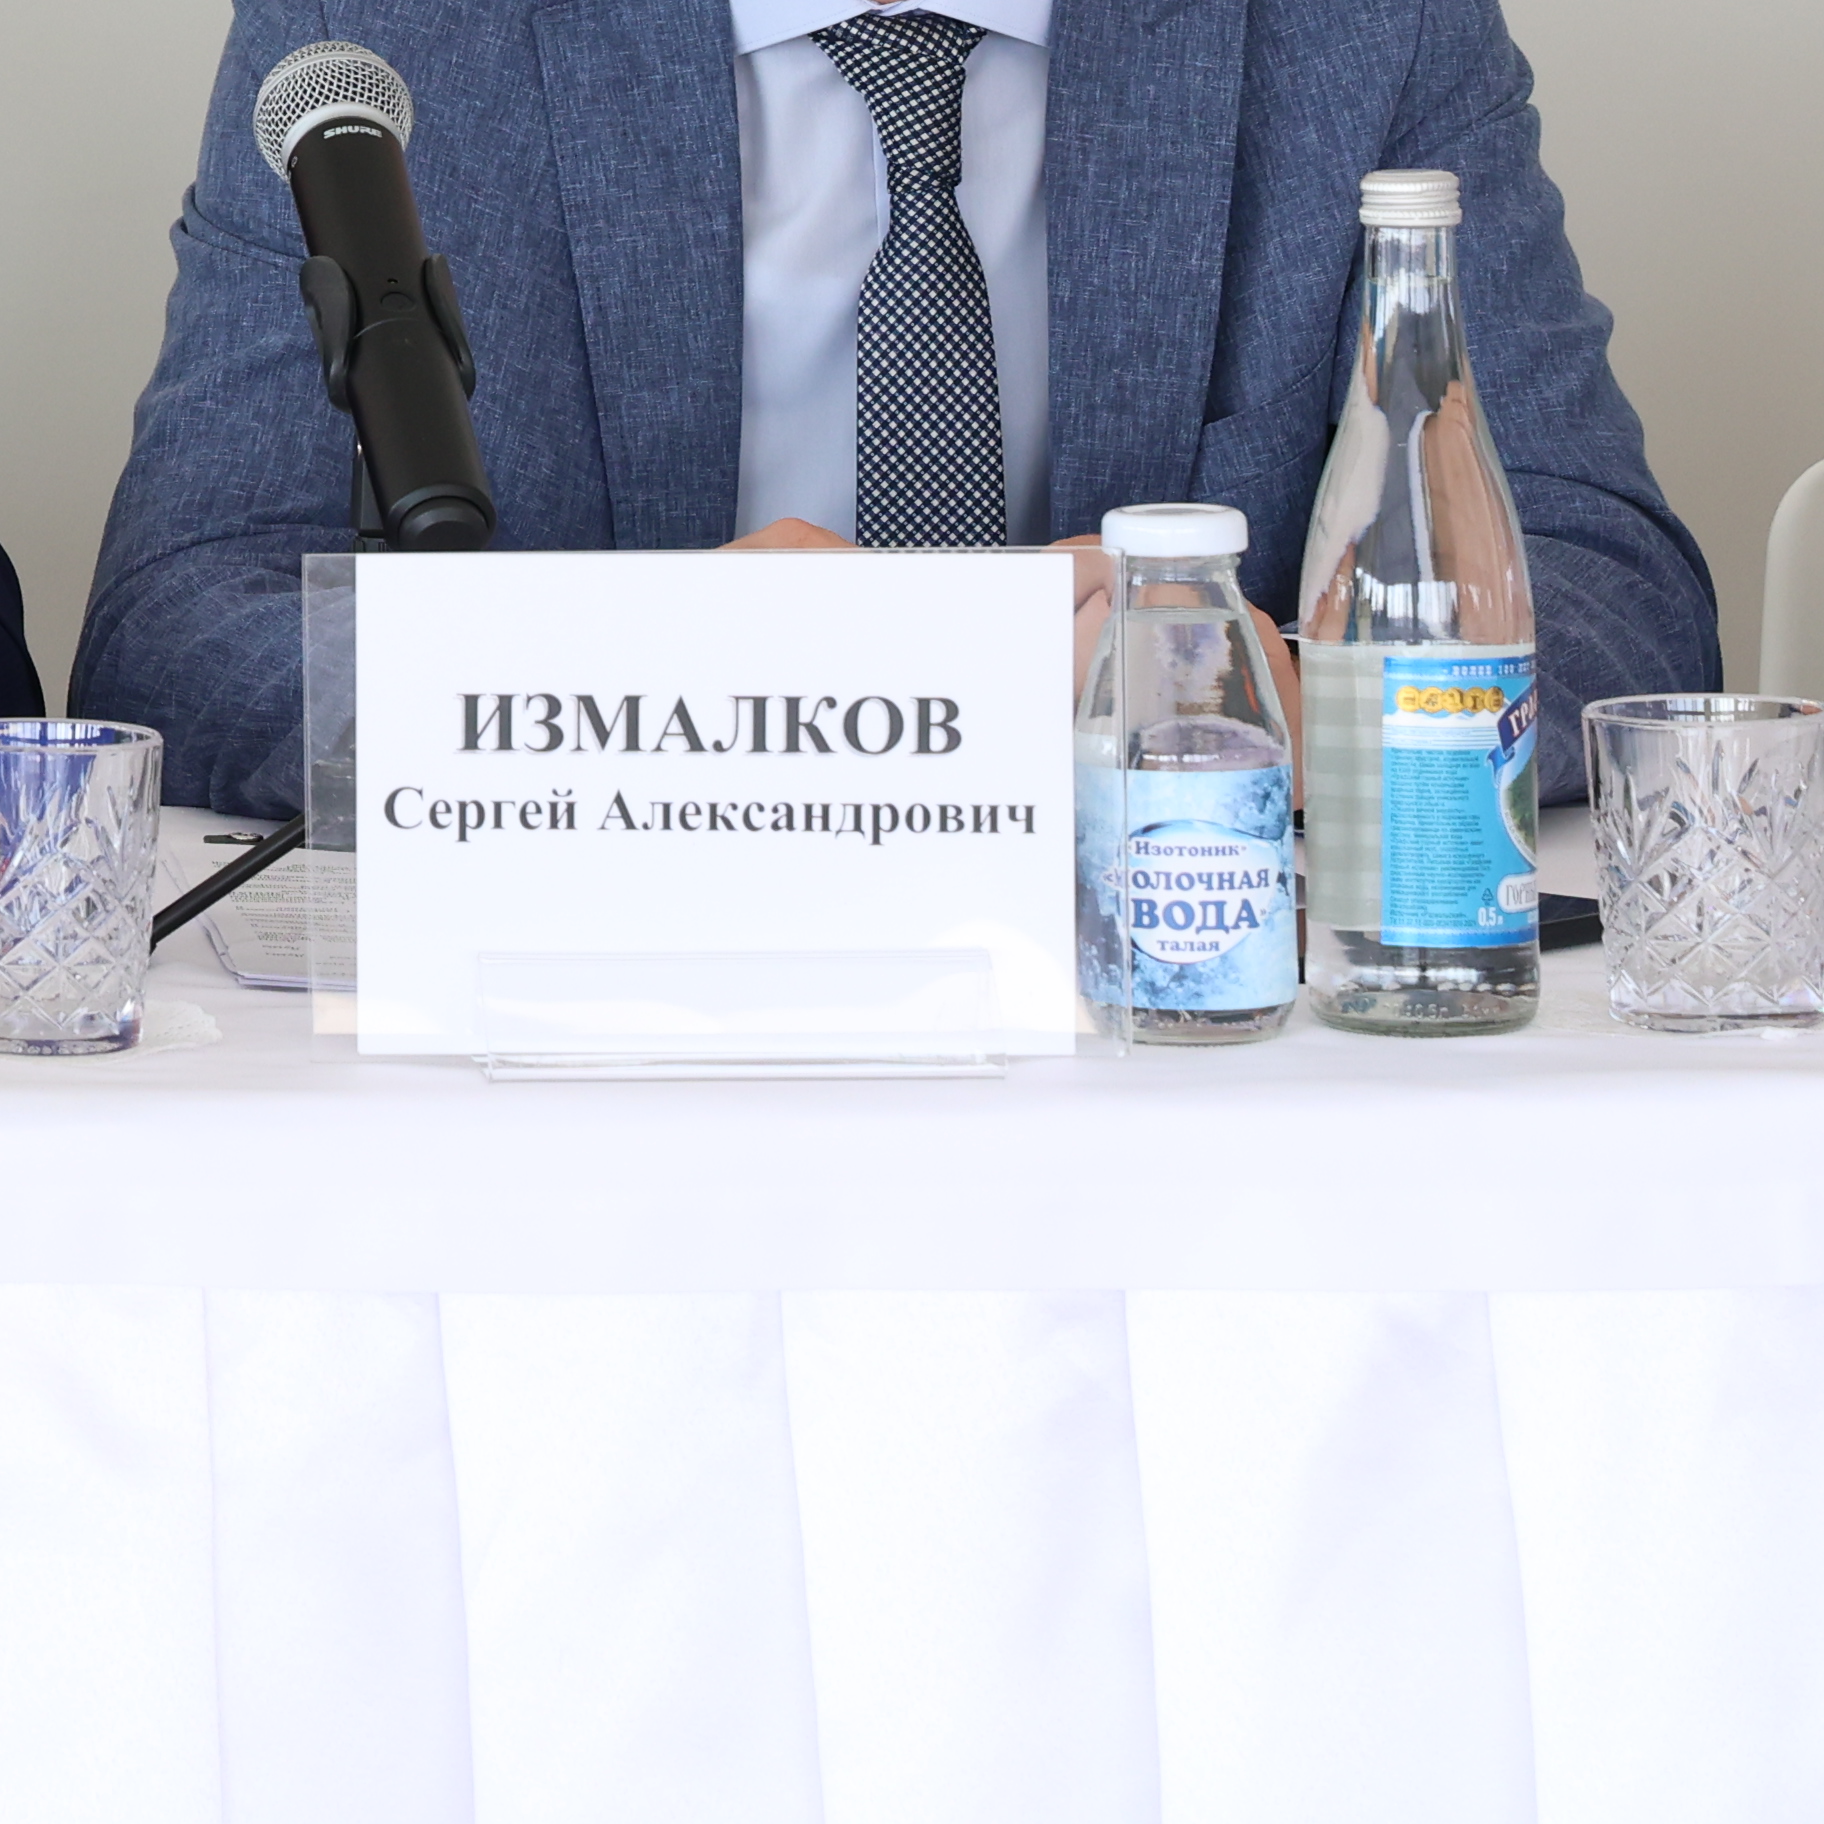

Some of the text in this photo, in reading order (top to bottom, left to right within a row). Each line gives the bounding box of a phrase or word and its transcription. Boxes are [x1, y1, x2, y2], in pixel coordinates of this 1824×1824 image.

[323, 125, 383, 140] SHURE
[457, 692, 964, 757] ИЗМАЛКОВ
[383, 786, 1036, 846] Сергей Александрович
[1131, 898, 1267, 935] ВОДА»
[1156, 940, 1220, 952] талая
